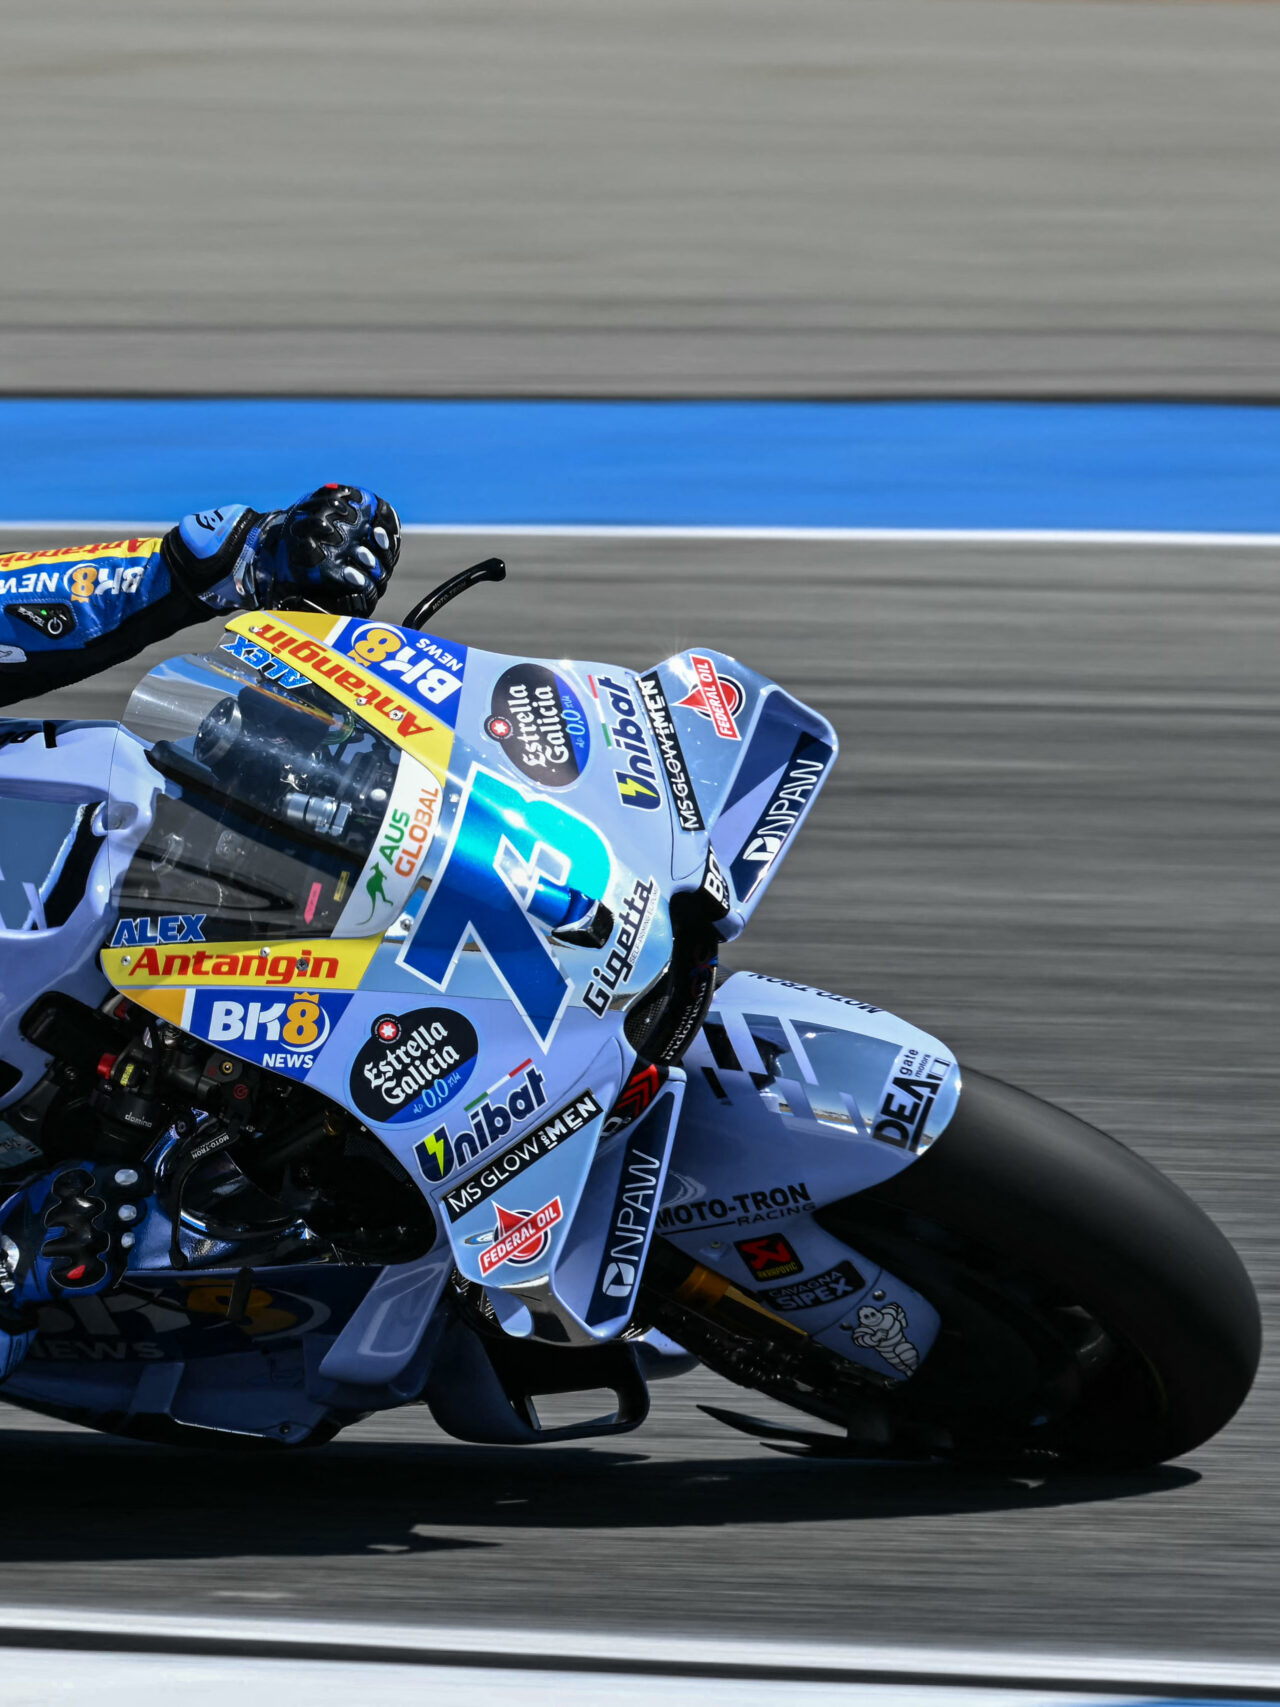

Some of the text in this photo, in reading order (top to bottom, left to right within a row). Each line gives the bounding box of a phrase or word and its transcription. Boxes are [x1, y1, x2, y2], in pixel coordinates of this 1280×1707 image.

[71, 566, 145, 598] BK8
[220, 634, 312, 689] ALEX
[256, 623, 434, 738] Antangin
[354, 628, 464, 705] BK8
[416, 638, 464, 672] NEWS
[508, 684, 548, 768] Estrella
[532, 685, 570, 764] Galicia
[697, 662, 734, 736] FEDERAL OIL
[596, 675, 662, 812] Unibat
[378, 808, 410, 866] AUS
[394, 788, 439, 878] GLOBAL
[677, 800, 699, 830] MS
[110, 913, 208, 947] ALEX
[582, 877, 656, 1018] Gigetta
[128, 947, 340, 985] Antangin
[208, 998, 324, 1047] BK8
[262, 1053, 314, 1069] NEWS
[363, 1021, 449, 1090] Estrella
[381, 1045, 460, 1105] Galicia
[899, 1048, 919, 1077] gate
[914, 1053, 932, 1079] motors
[191, 1133, 230, 1160] MOTO-TRON
[414, 1064, 549, 1184] Unibat
[447, 1184, 483, 1214] MS
[479, 1136, 541, 1192] GLOW
[548, 1096, 598, 1146] MEN
[655, 1182, 813, 1229] MOTO-TRON
[736, 1201, 818, 1228] RACING
[482, 1208, 559, 1267] FEDERAL OIL
[769, 1270, 844, 1298] CAVAGNA
[777, 1276, 854, 1310] SIPEX
